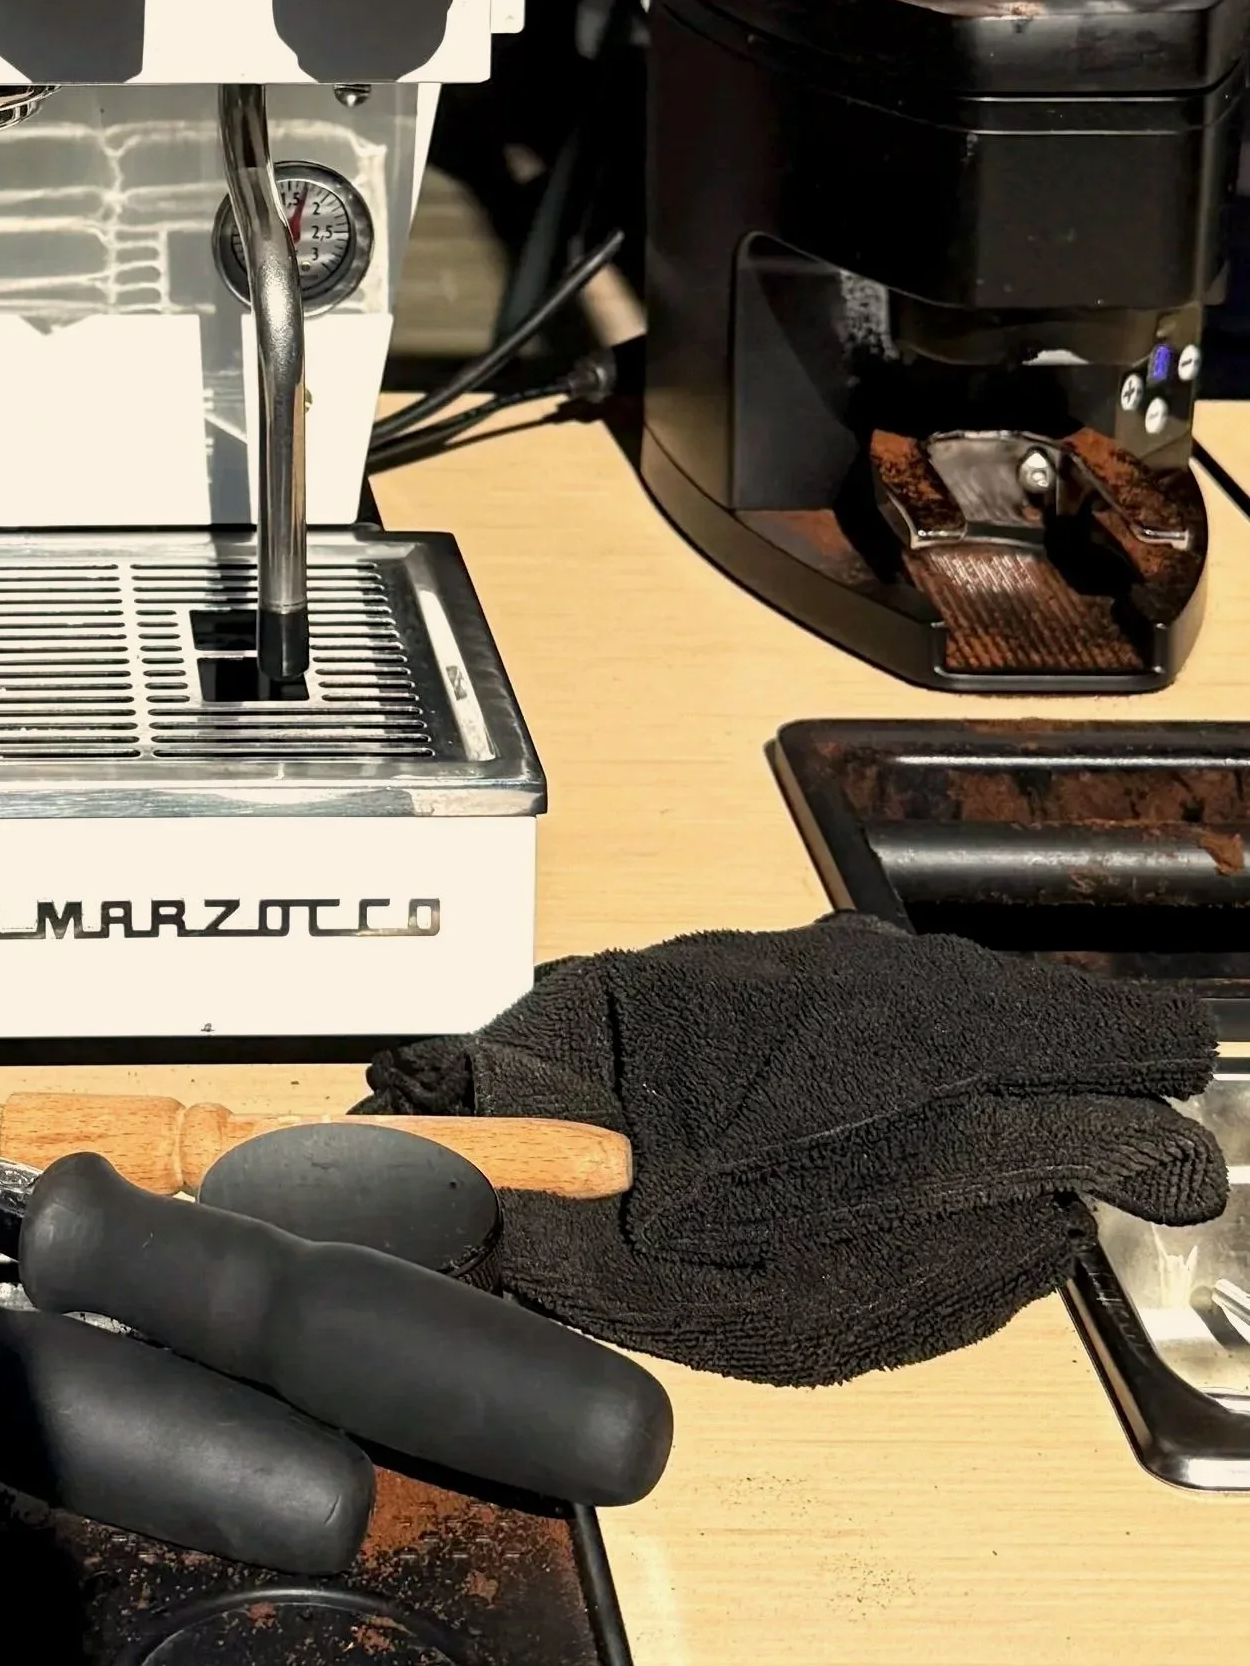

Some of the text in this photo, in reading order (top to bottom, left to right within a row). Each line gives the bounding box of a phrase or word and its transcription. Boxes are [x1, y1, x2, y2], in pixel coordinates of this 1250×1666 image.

[312, 202, 320, 215] 2
[311, 225, 332, 241] 2,5
[312, 247, 318, 260] 3
